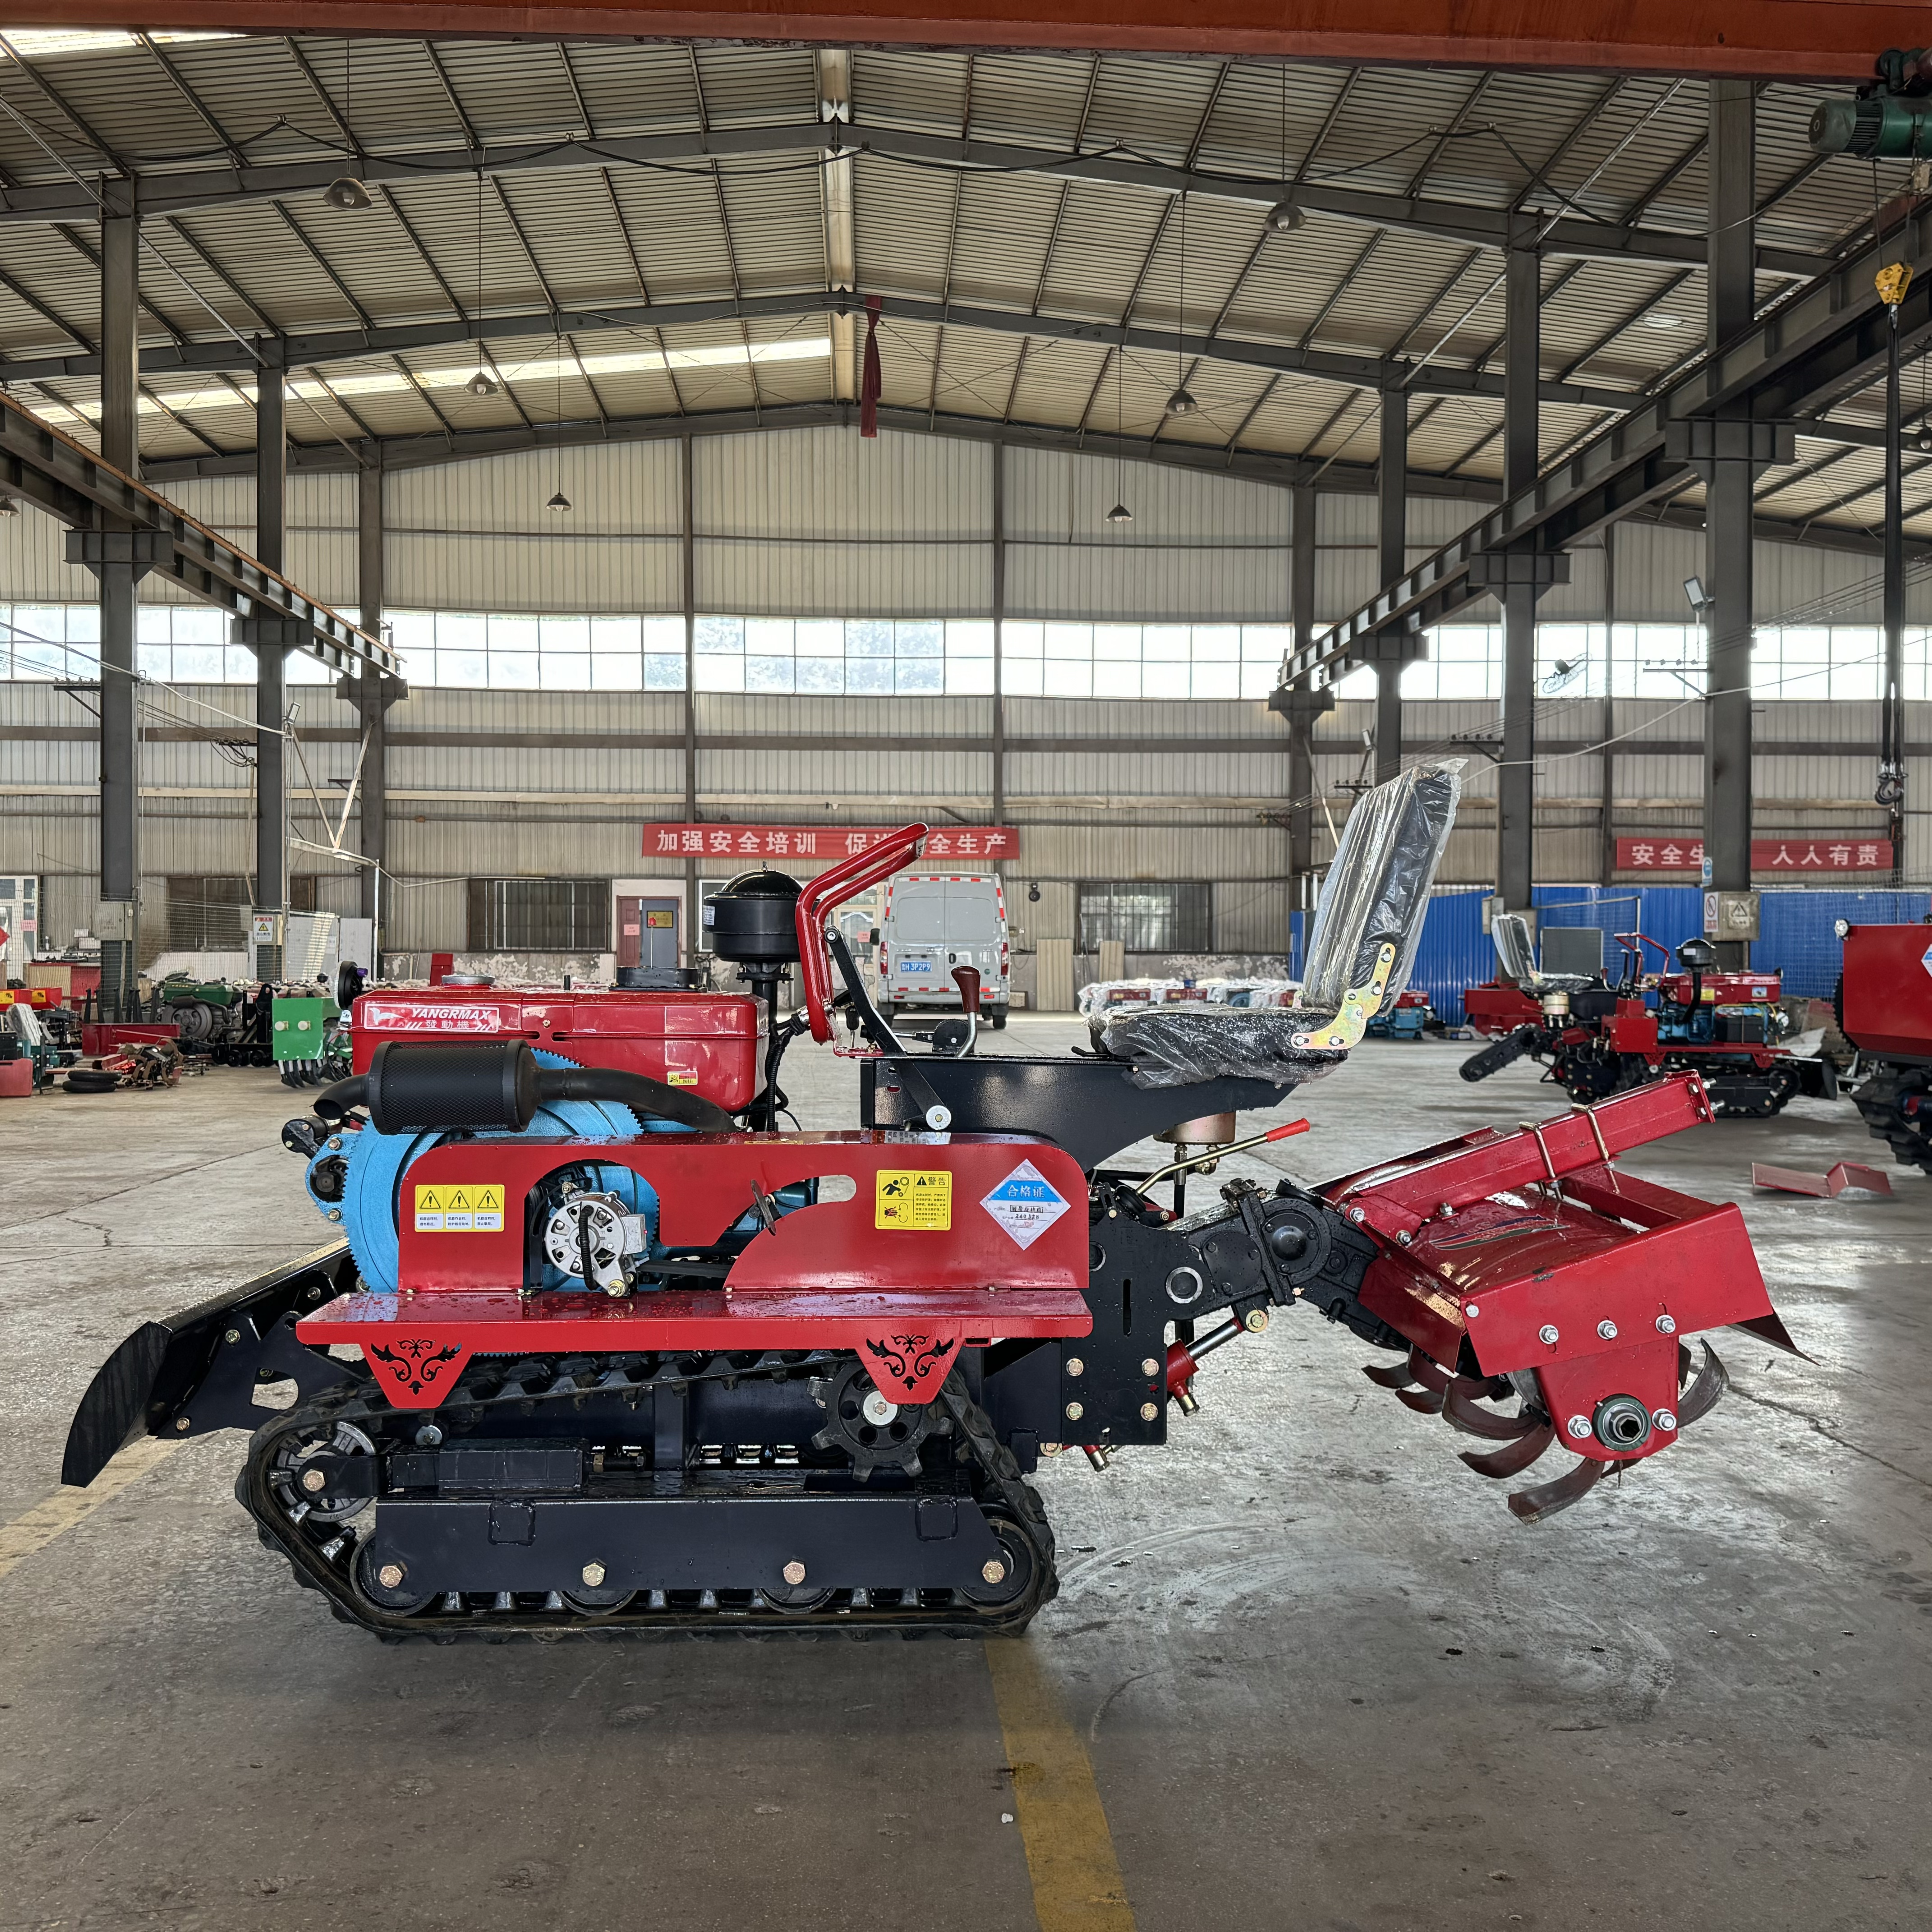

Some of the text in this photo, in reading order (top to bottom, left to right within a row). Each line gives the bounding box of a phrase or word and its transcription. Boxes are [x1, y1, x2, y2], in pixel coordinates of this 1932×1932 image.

[657, 830, 1007, 855] 加强安全培训 促全生产
[1771, 844, 1879, 866] 人人有责
[411, 1007, 492, 1020] YANGRMAX
[425, 1019, 469, 1030] 發動機
[928, 1177, 946, 1186] 警告
[1007, 1185, 1045, 1198] 合格证
